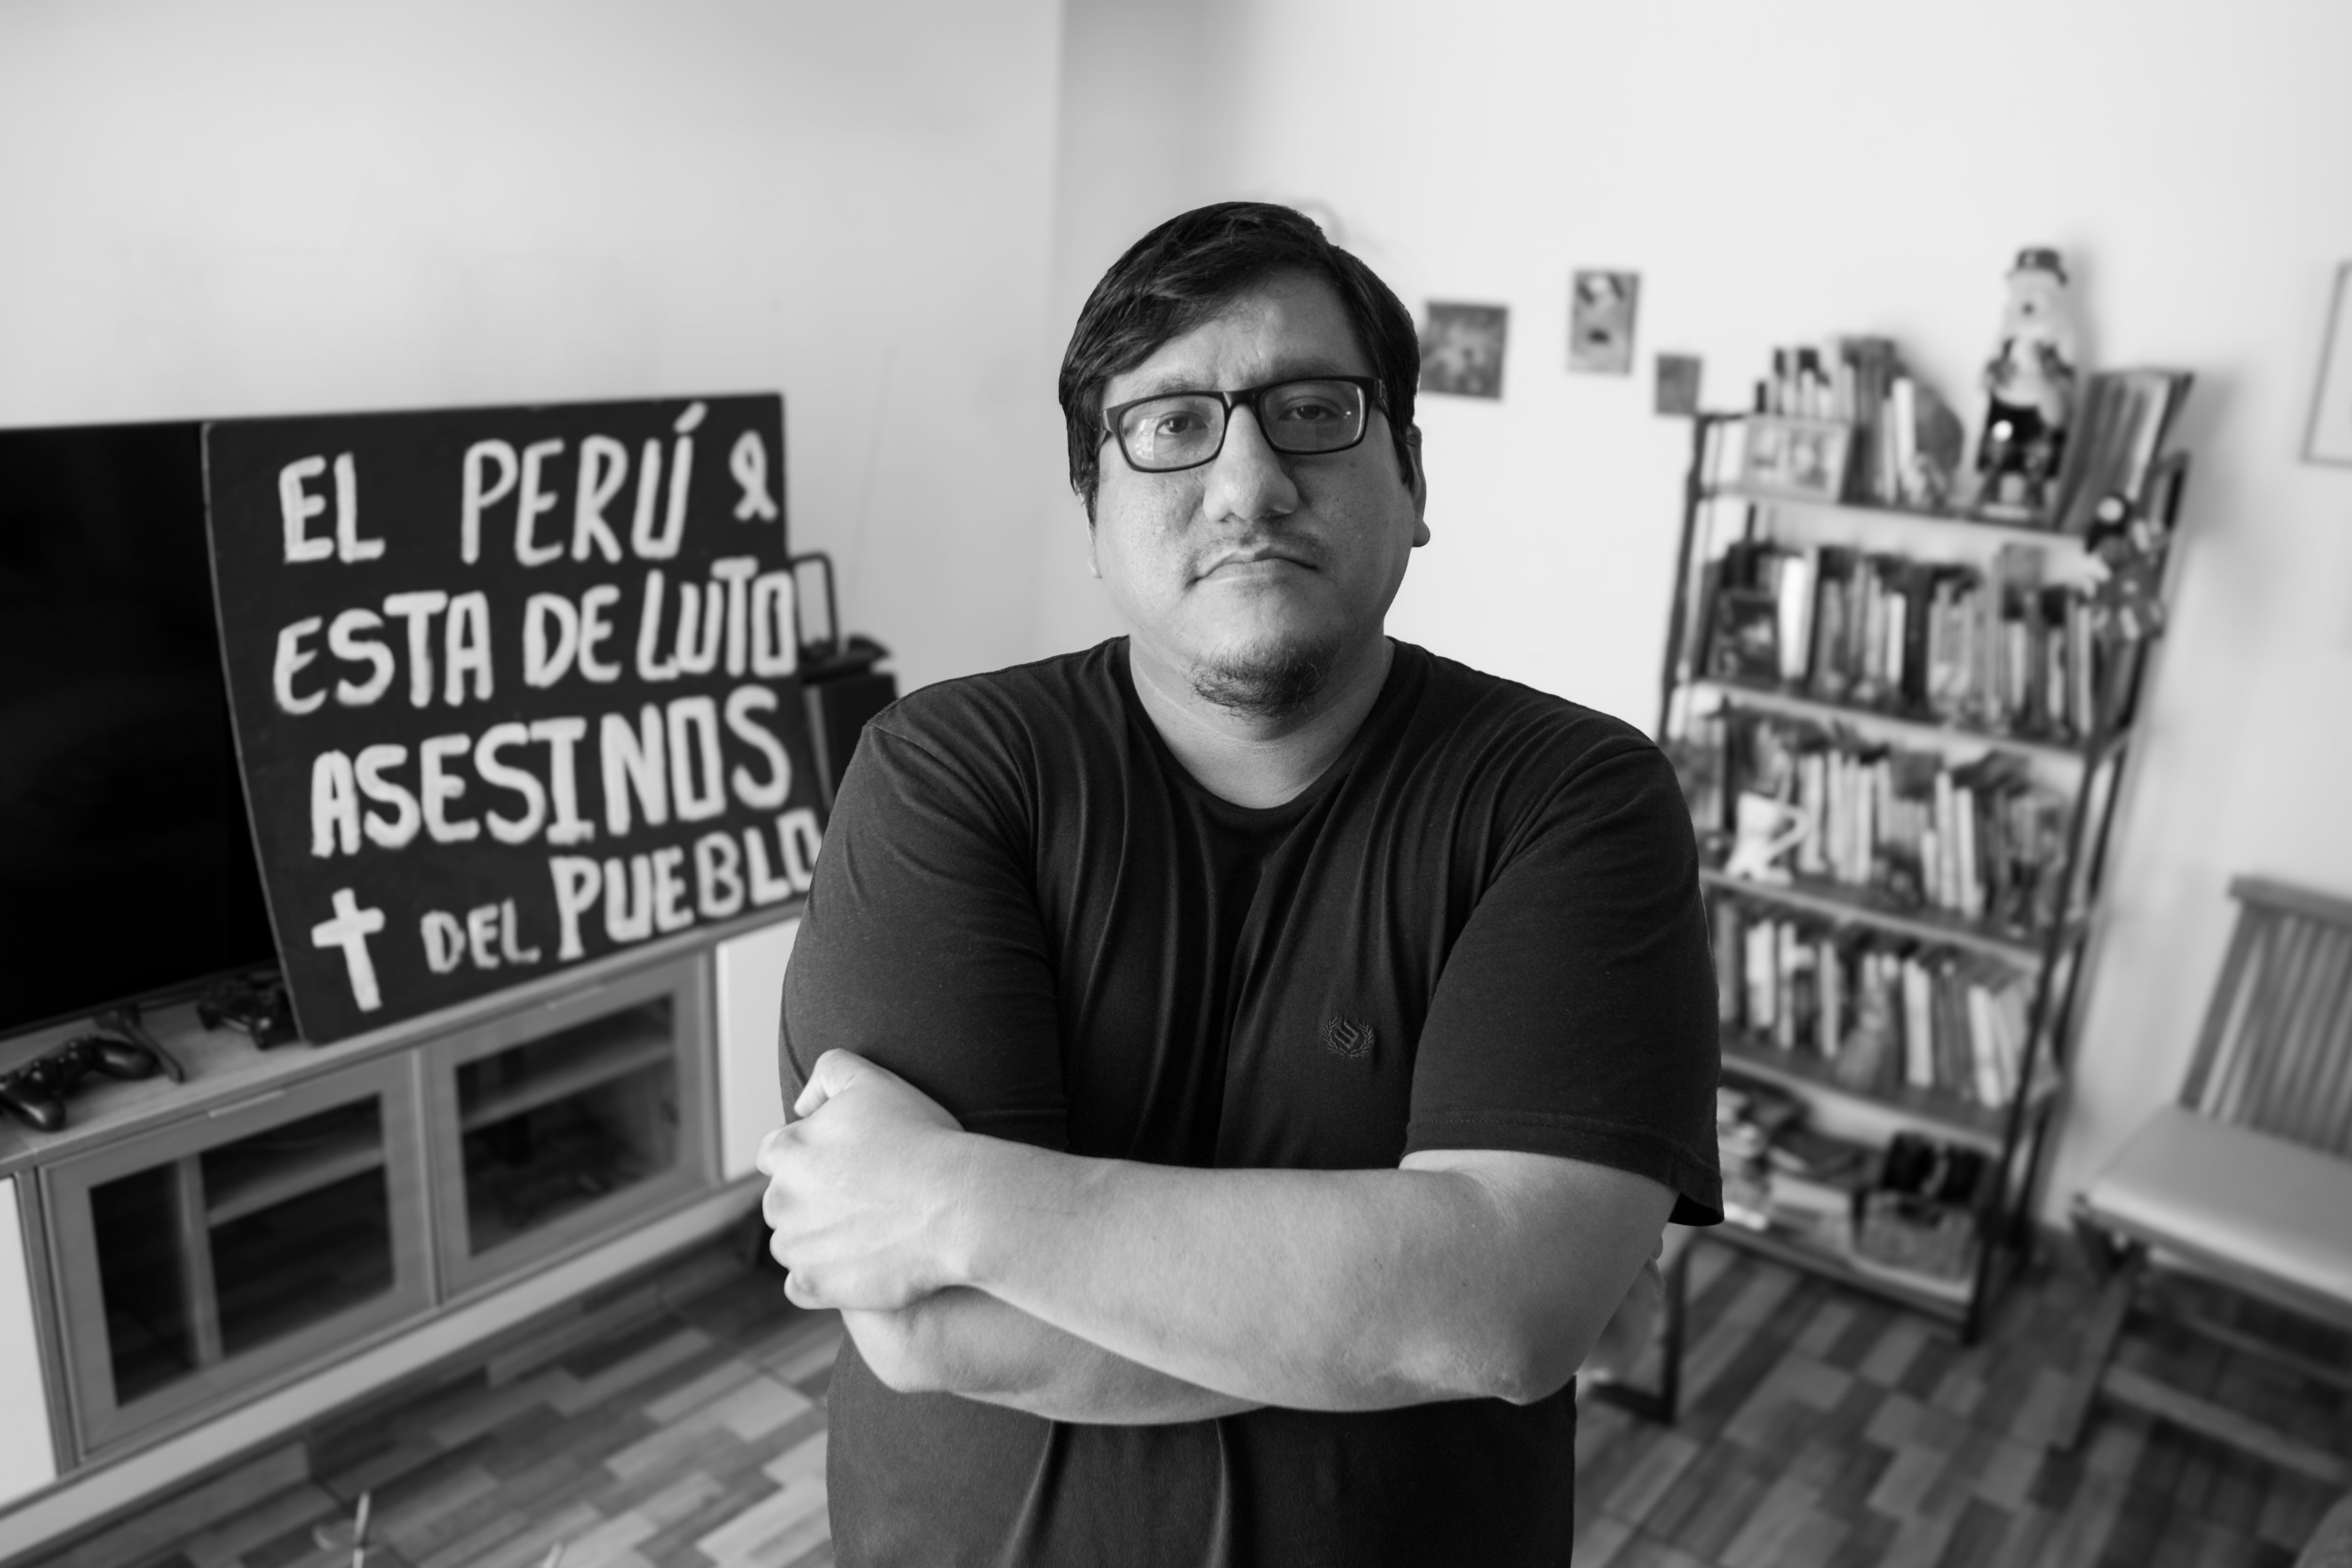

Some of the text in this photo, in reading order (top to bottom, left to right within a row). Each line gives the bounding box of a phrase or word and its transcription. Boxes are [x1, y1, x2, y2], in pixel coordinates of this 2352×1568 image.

[279, 403, 706, 566] EL PERÚ
[273, 557, 796, 714] ESTA DE LUTO
[311, 685, 791, 858] ASESINOS
[421, 809, 821, 972] DEL PUEBLO
